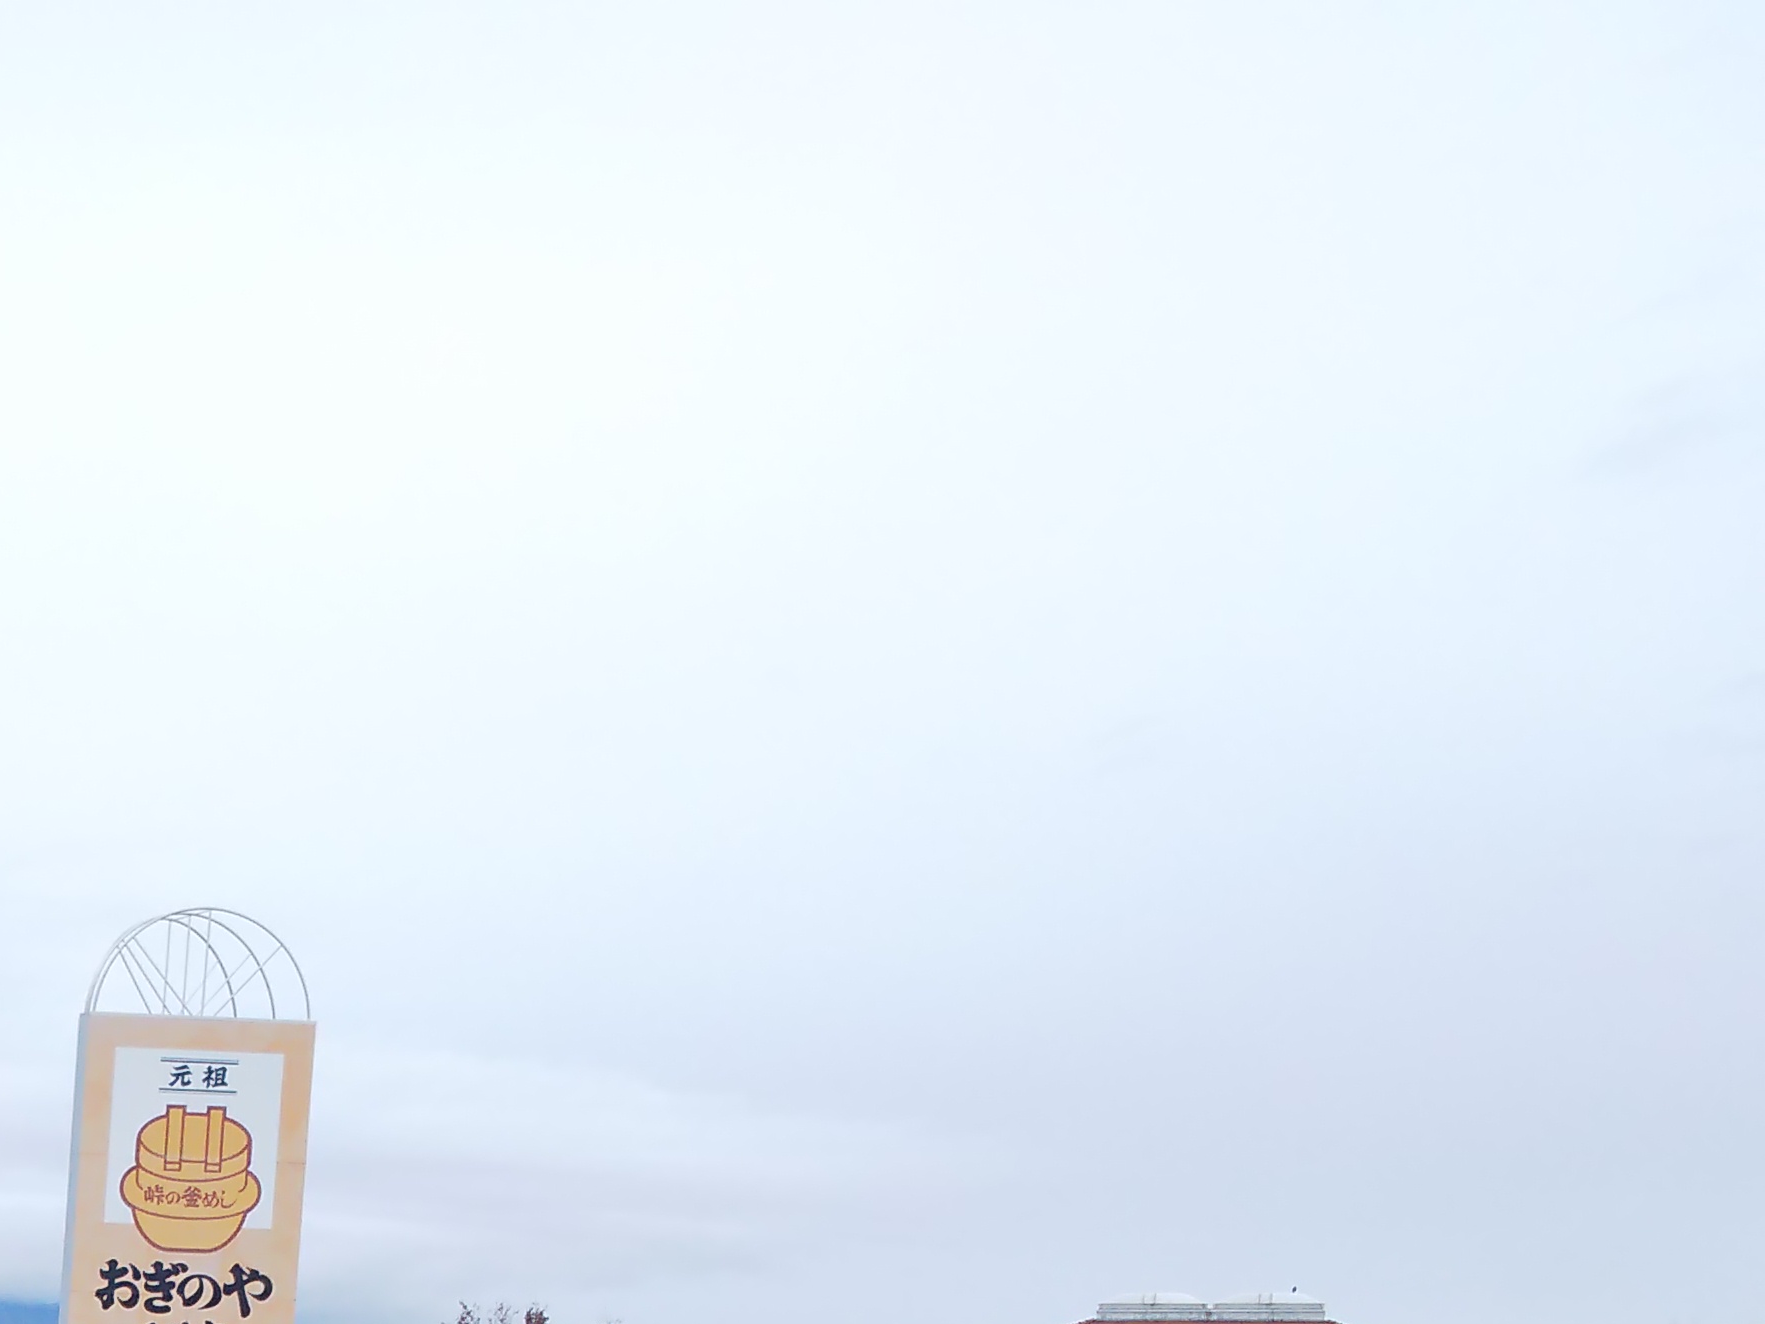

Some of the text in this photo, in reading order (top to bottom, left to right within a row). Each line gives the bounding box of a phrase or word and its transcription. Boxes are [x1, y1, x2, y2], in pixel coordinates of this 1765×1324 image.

[168, 1064, 229, 1089] 元祖
[143, 1185, 237, 1210] 峠の釜めし
[95, 1258, 273, 1319] おぎのや
